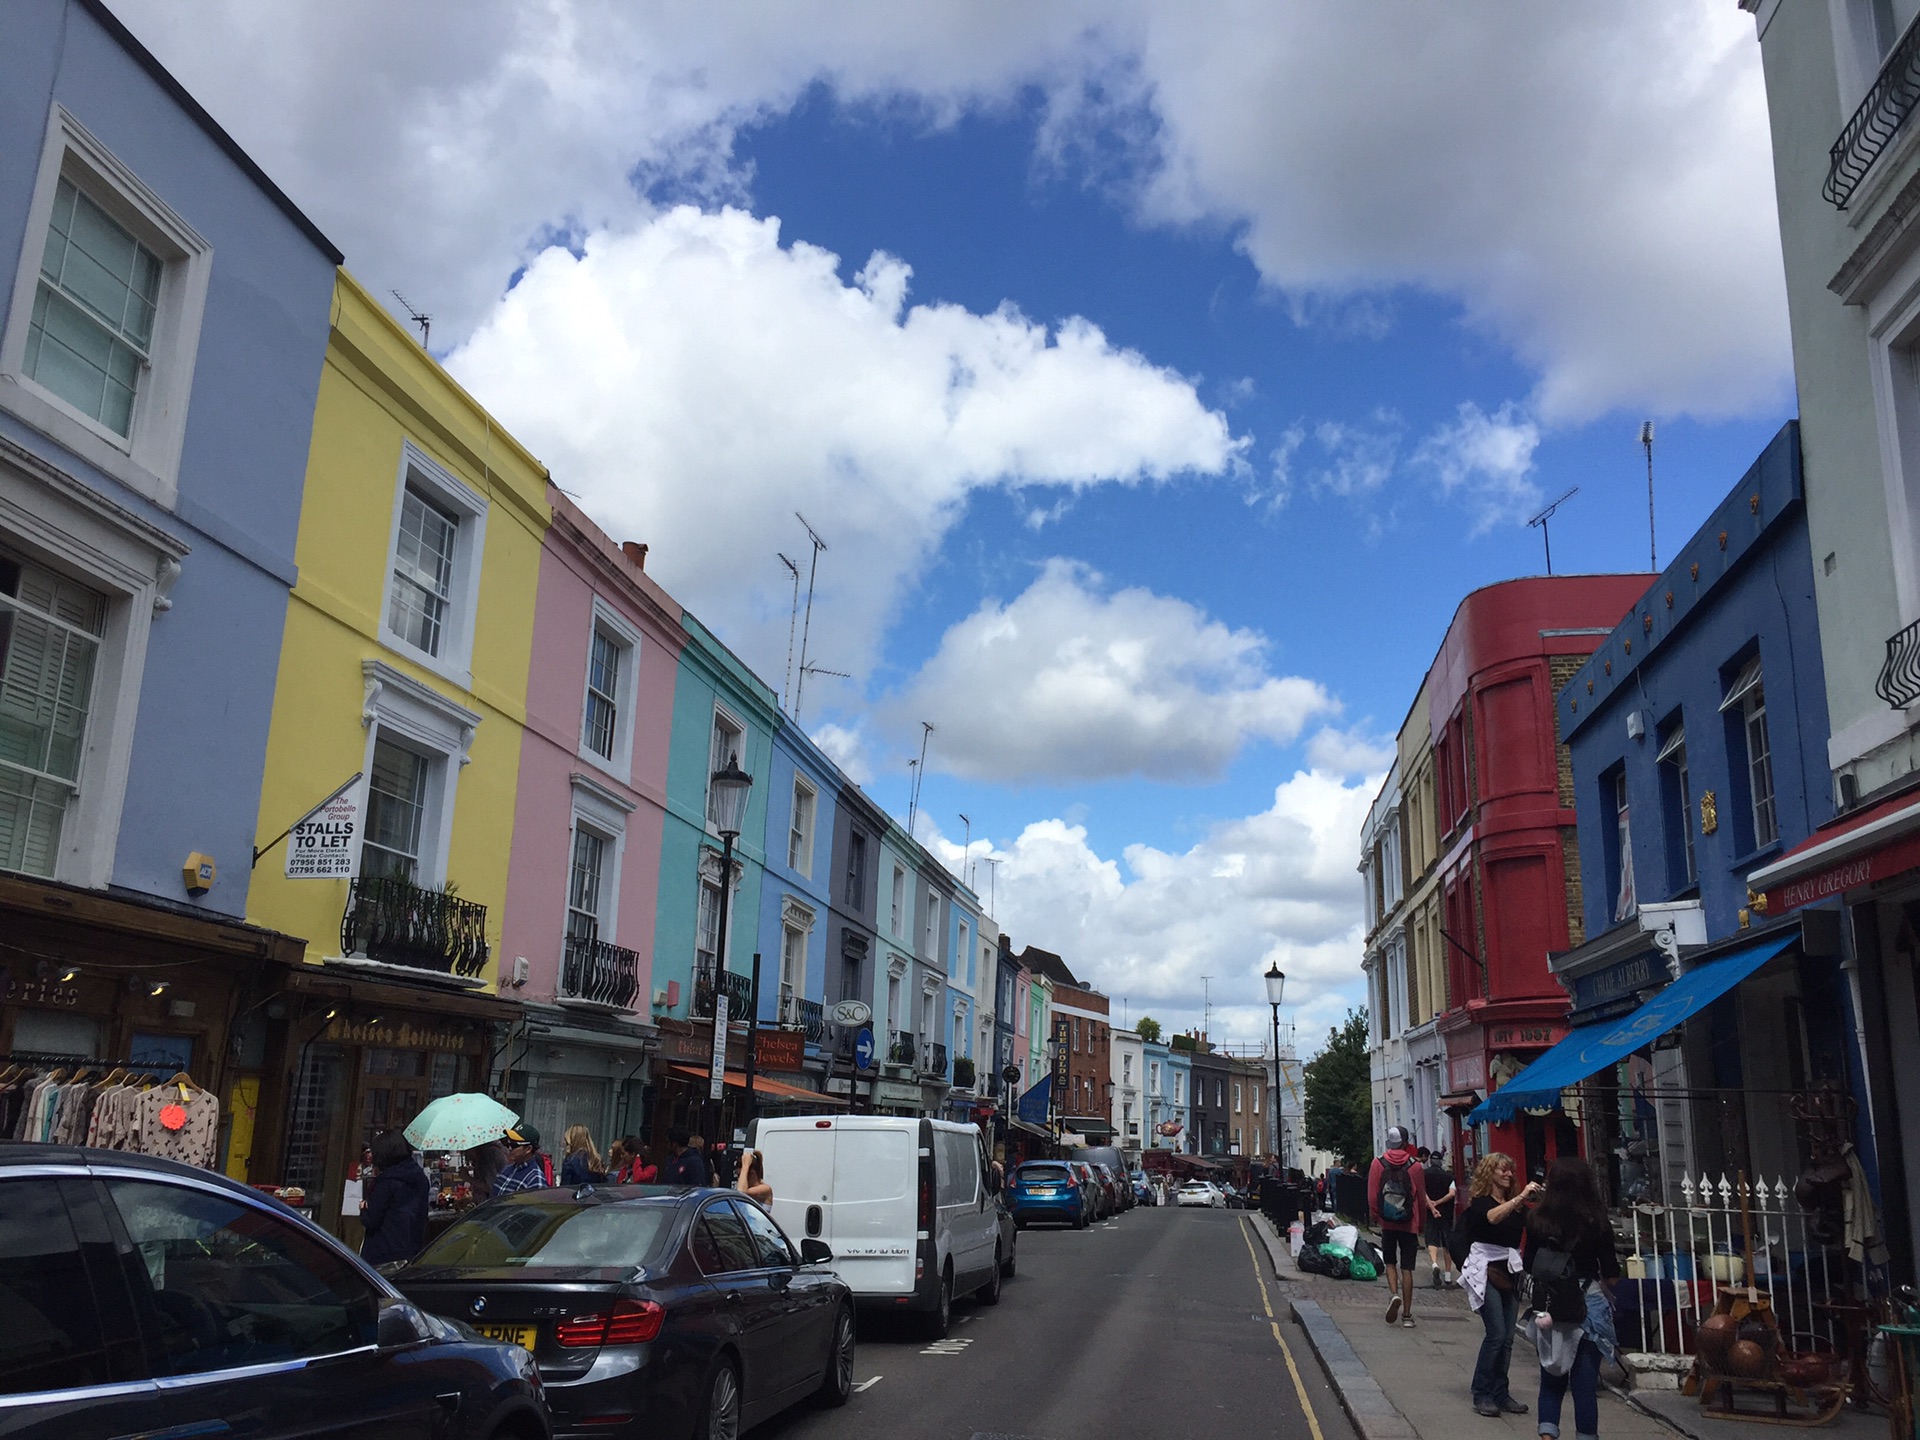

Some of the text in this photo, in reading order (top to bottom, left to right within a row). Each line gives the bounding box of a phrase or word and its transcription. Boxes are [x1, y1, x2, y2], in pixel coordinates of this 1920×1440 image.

[336, 797, 348, 805] The
[320, 805, 357, 813] Portobello
[328, 813, 350, 821] Group
[295, 822, 354, 835] STALLS
[296, 836, 351, 848] TO LET
[1783, 858, 1872, 907] HENRY GREGORY
[837, 1005, 864, 1021] S&C
[1059, 1024, 1067, 1044] THE
[754, 1036, 799, 1051] Chelsea
[755, 1049, 796, 1065] Jewels
[1058, 1047, 1067, 1074] GOLD
